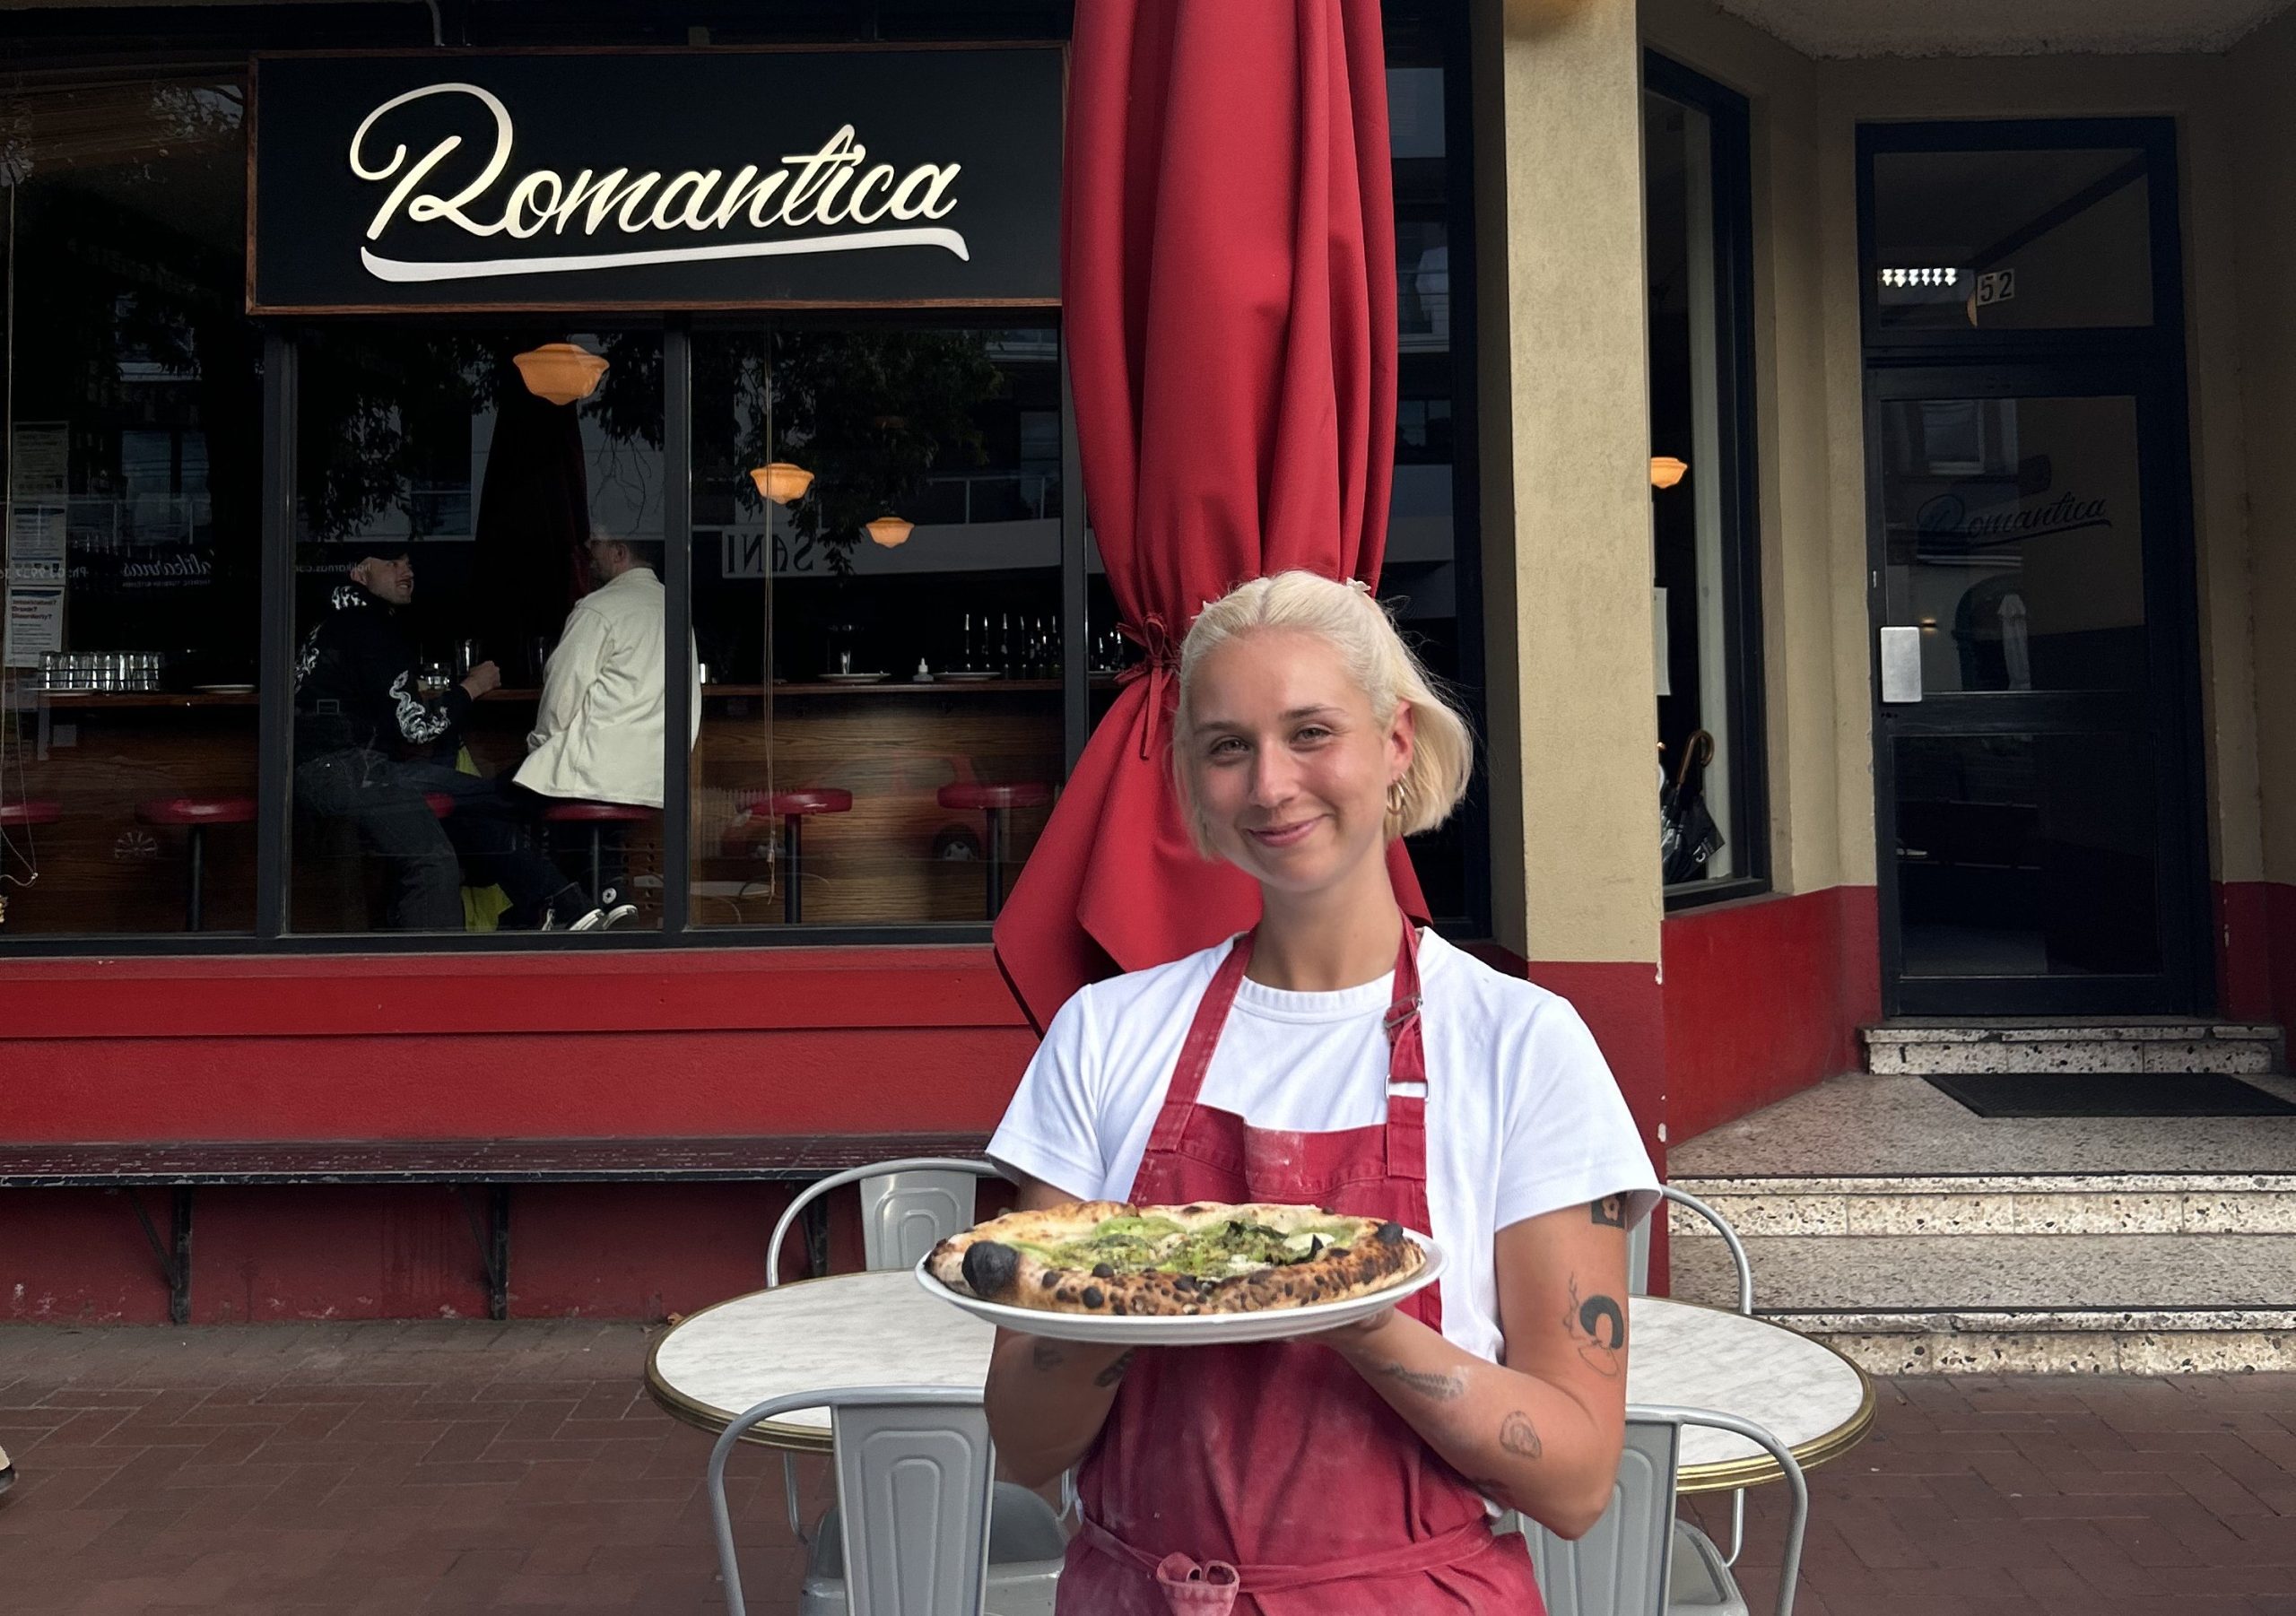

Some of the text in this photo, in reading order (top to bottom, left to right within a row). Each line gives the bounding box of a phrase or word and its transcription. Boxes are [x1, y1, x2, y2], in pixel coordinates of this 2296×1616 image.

[350, 82, 961, 241] Romantica
[1979, 271, 2013, 302] 52
[1916, 491, 2106, 538] Romantica
